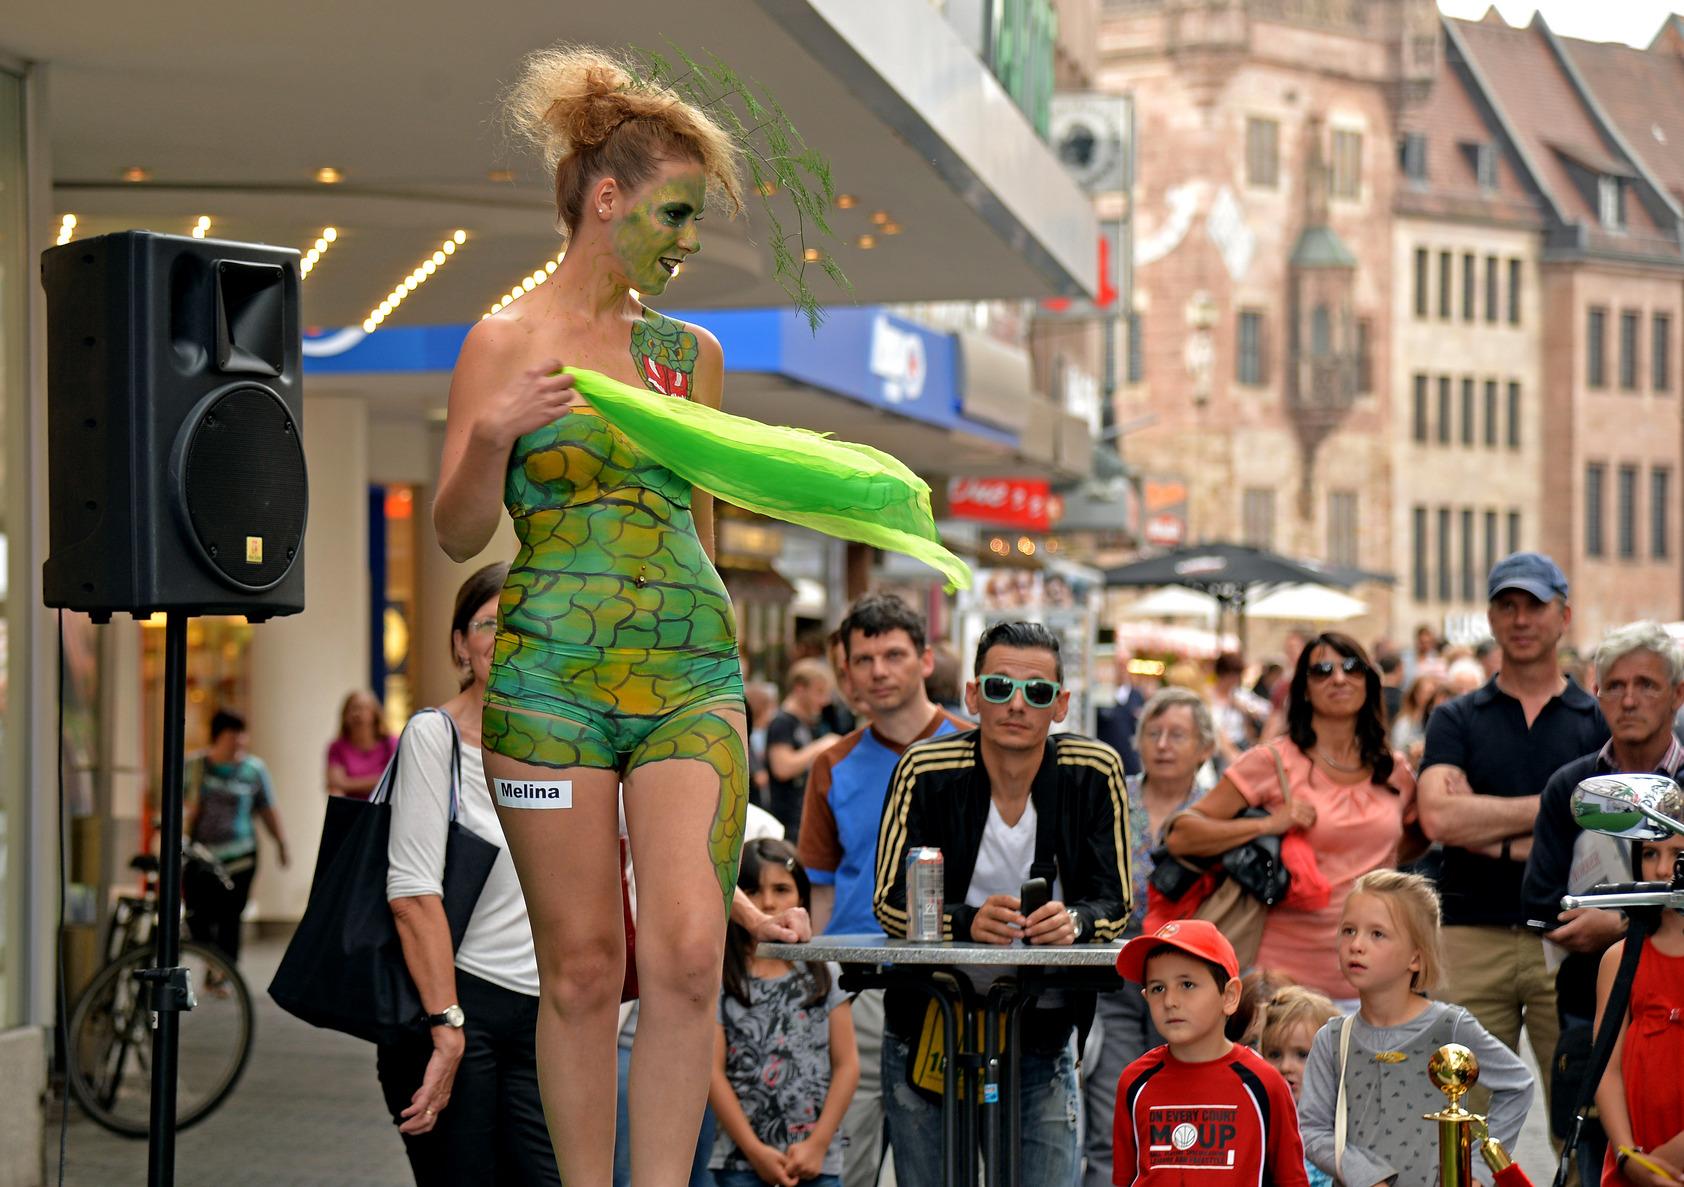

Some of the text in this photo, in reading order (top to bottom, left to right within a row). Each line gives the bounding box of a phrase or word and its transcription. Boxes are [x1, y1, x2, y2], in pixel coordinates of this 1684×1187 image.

[501, 782, 560, 799] Melina
[1150, 1110, 1237, 1122] ON EVERY COURT
